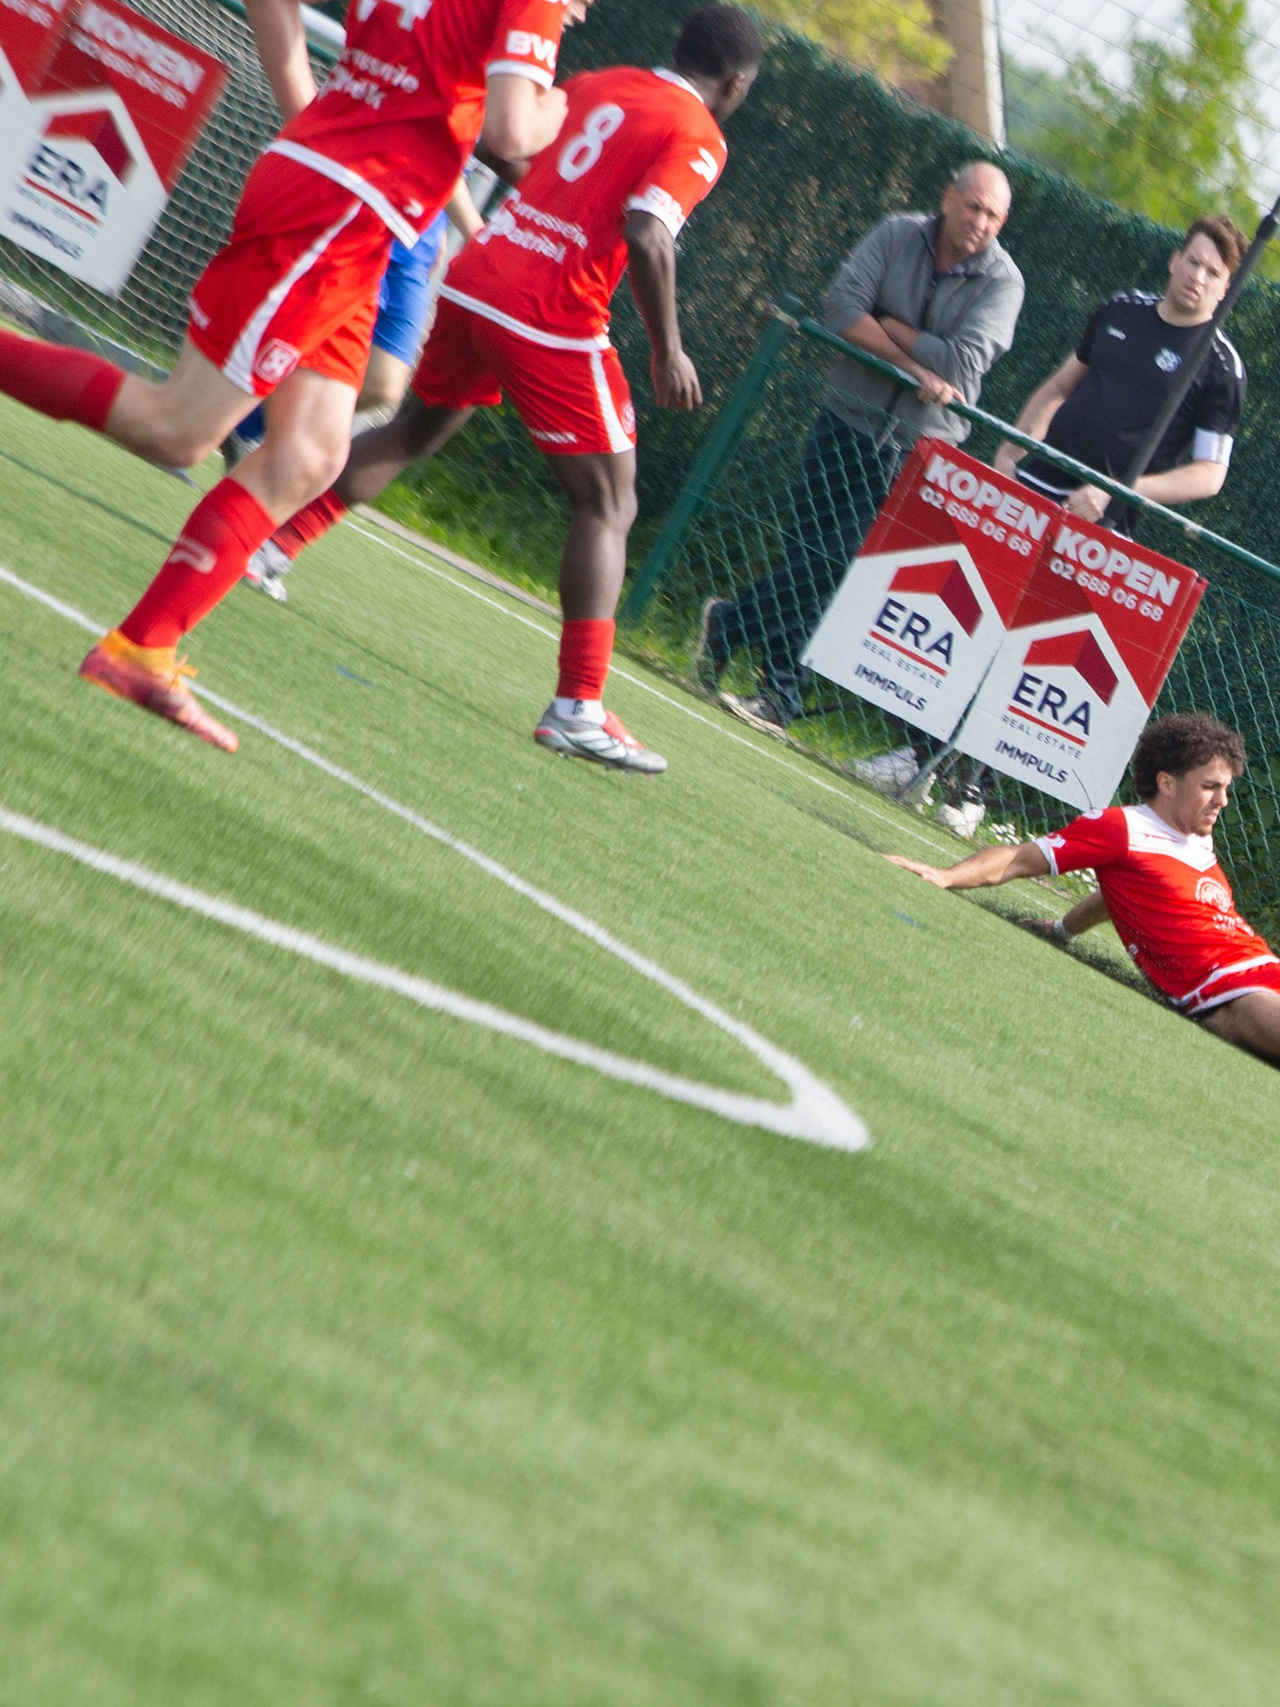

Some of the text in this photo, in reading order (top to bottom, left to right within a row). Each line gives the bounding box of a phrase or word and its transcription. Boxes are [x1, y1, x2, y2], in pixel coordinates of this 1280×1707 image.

[78, 2, 206, 96] KOPEN
[557, 102, 626, 184] 8
[27, 142, 110, 217] ERA
[919, 484, 1034, 557] 02 688 06 68
[924, 453, 1051, 541] KOPEN
[1049, 557, 1164, 622] 02 688 06 68
[1053, 525, 1181, 608] KOPEN
[862, 638, 943, 690] REAL ESTATE
[873, 597, 955, 667] ERA
[854, 663, 929, 712] IMMPULS
[1012, 671, 1091, 737] ERA
[994, 739, 1069, 784] IMMPULS
[1001, 714, 1082, 760] REAL ESTATE
